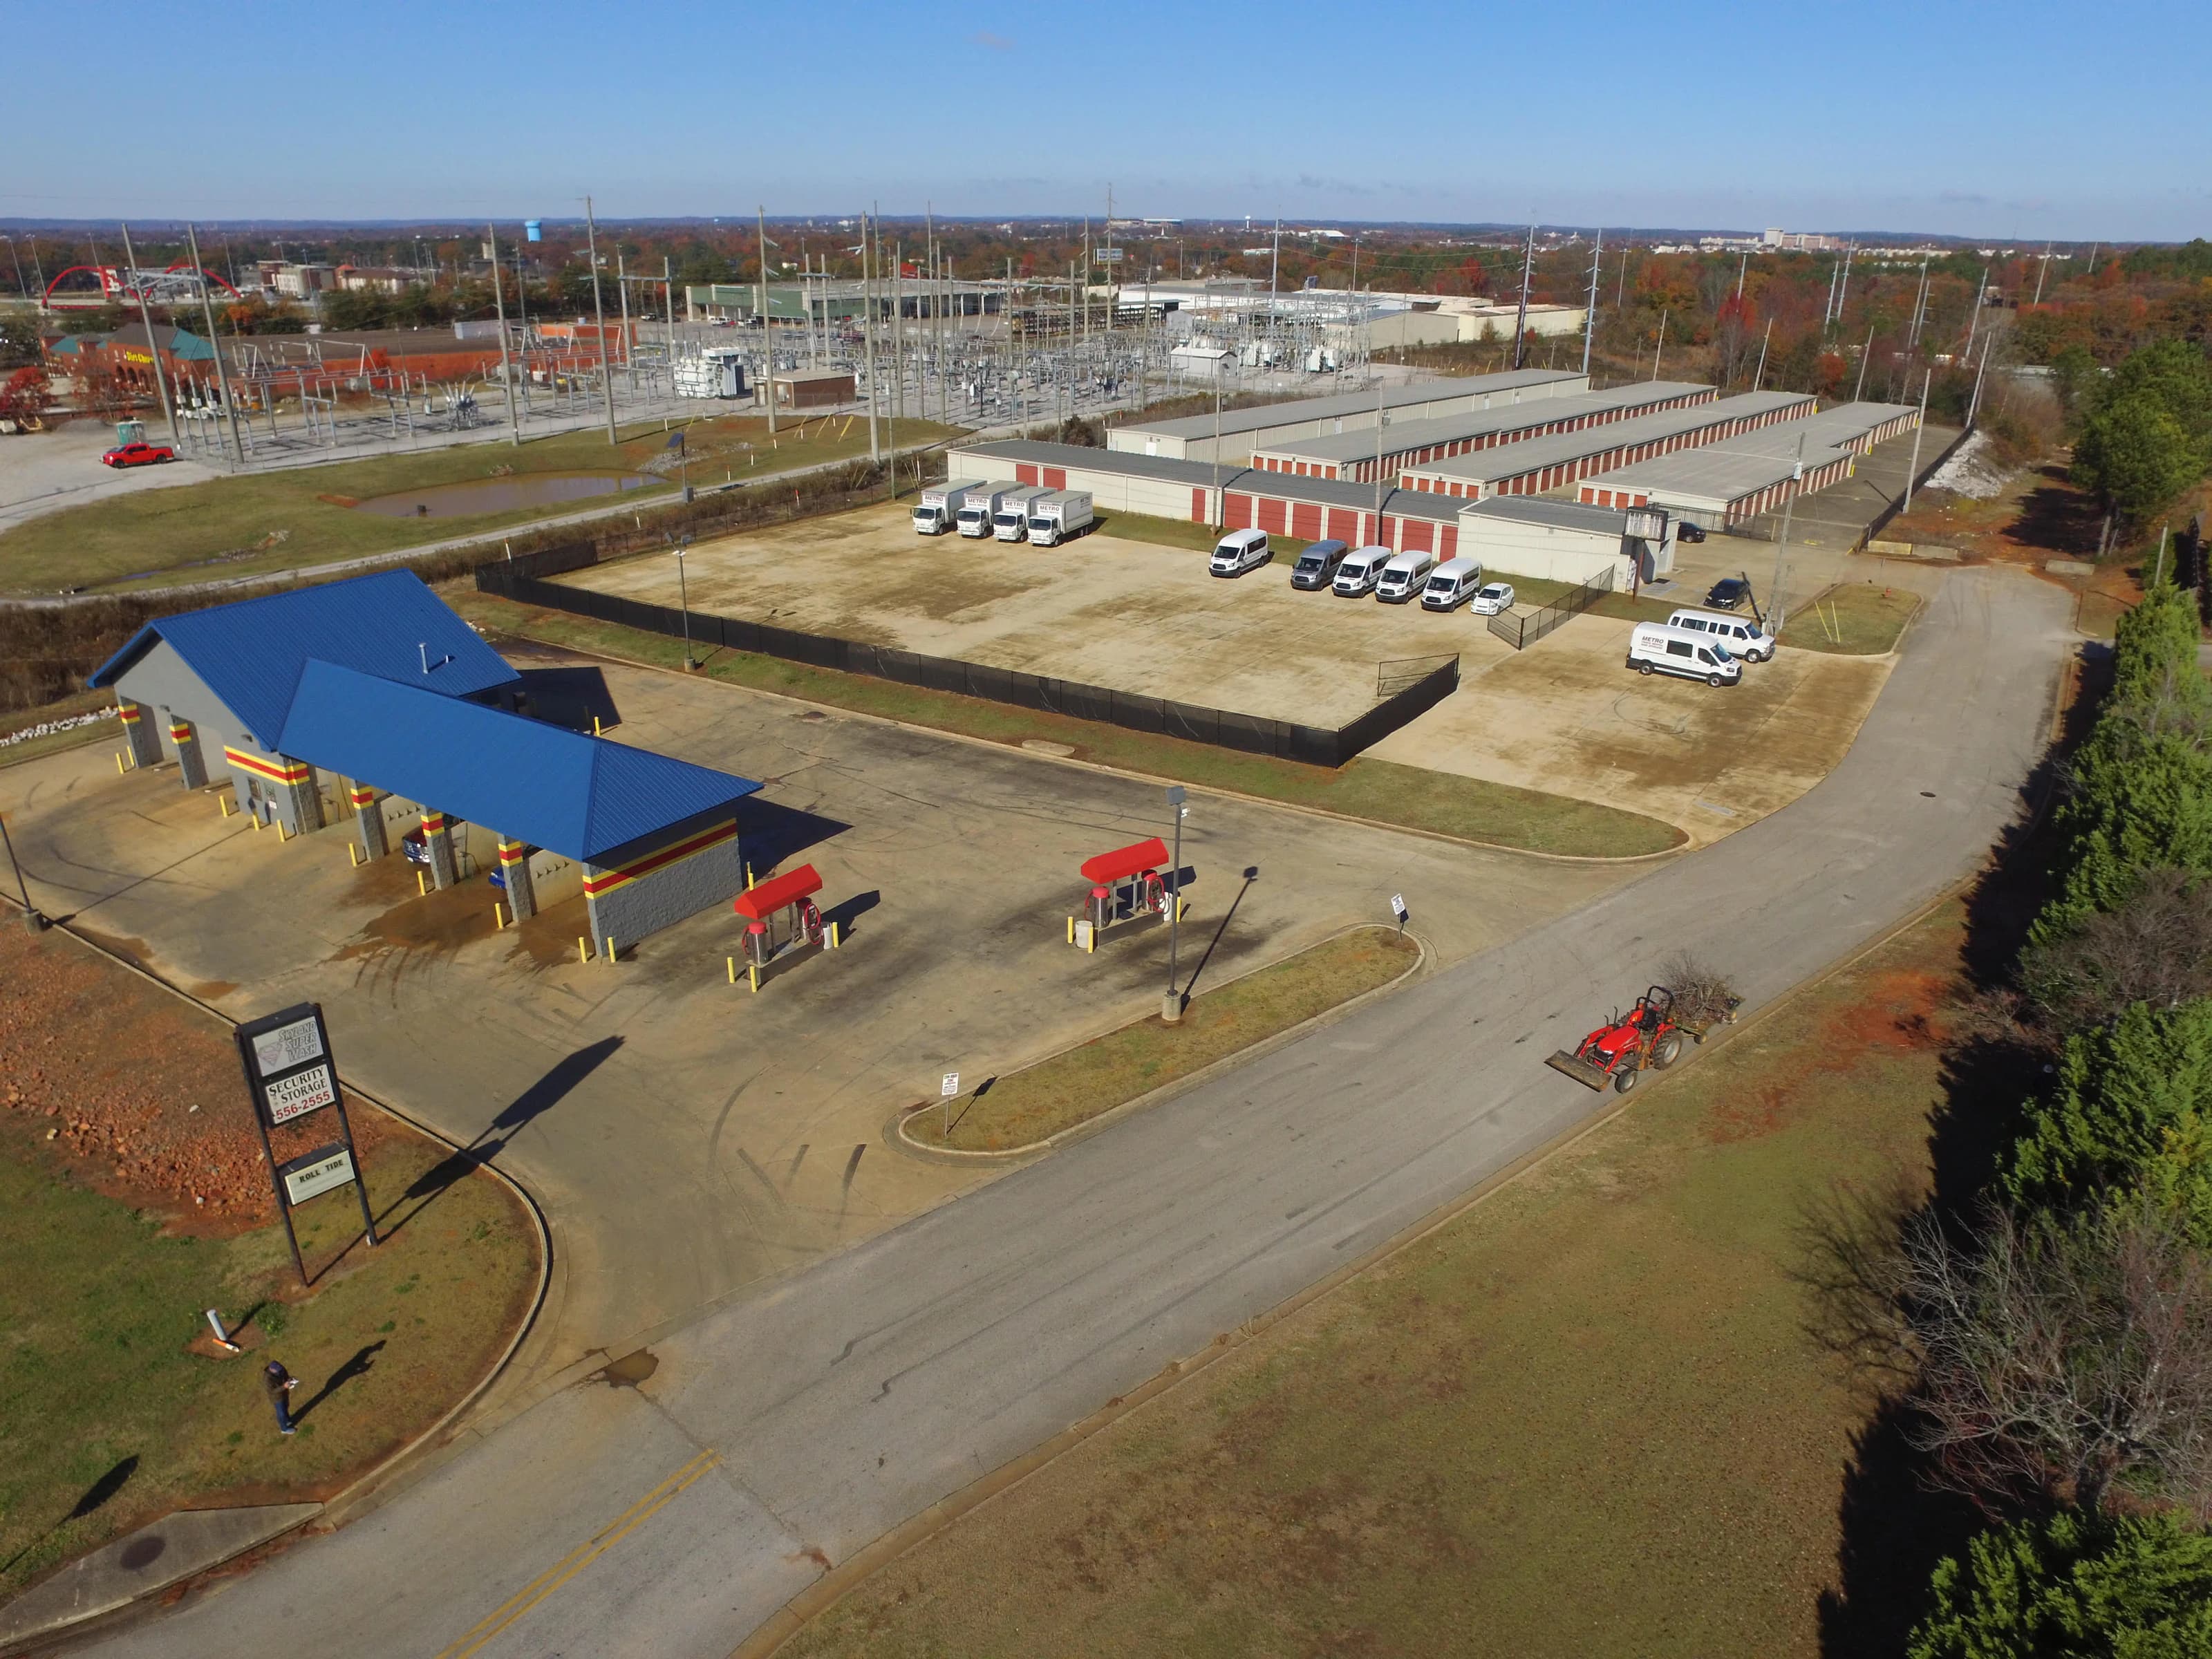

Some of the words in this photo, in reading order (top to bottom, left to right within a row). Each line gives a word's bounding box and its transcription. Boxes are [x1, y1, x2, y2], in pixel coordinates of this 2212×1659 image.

[1642, 635, 1664, 644] METRO
[279, 1021, 317, 1042] SKYLAND
[285, 1033, 317, 1051] SUPER
[288, 1042, 317, 1062] WASH
[269, 1067, 324, 1096] SECURITY
[281, 1078, 328, 1104] STORAGE
[276, 1091, 330, 1120] 556-2555
[299, 1170, 321, 1183] ROLL
[325, 1159, 344, 1171] TIDE
